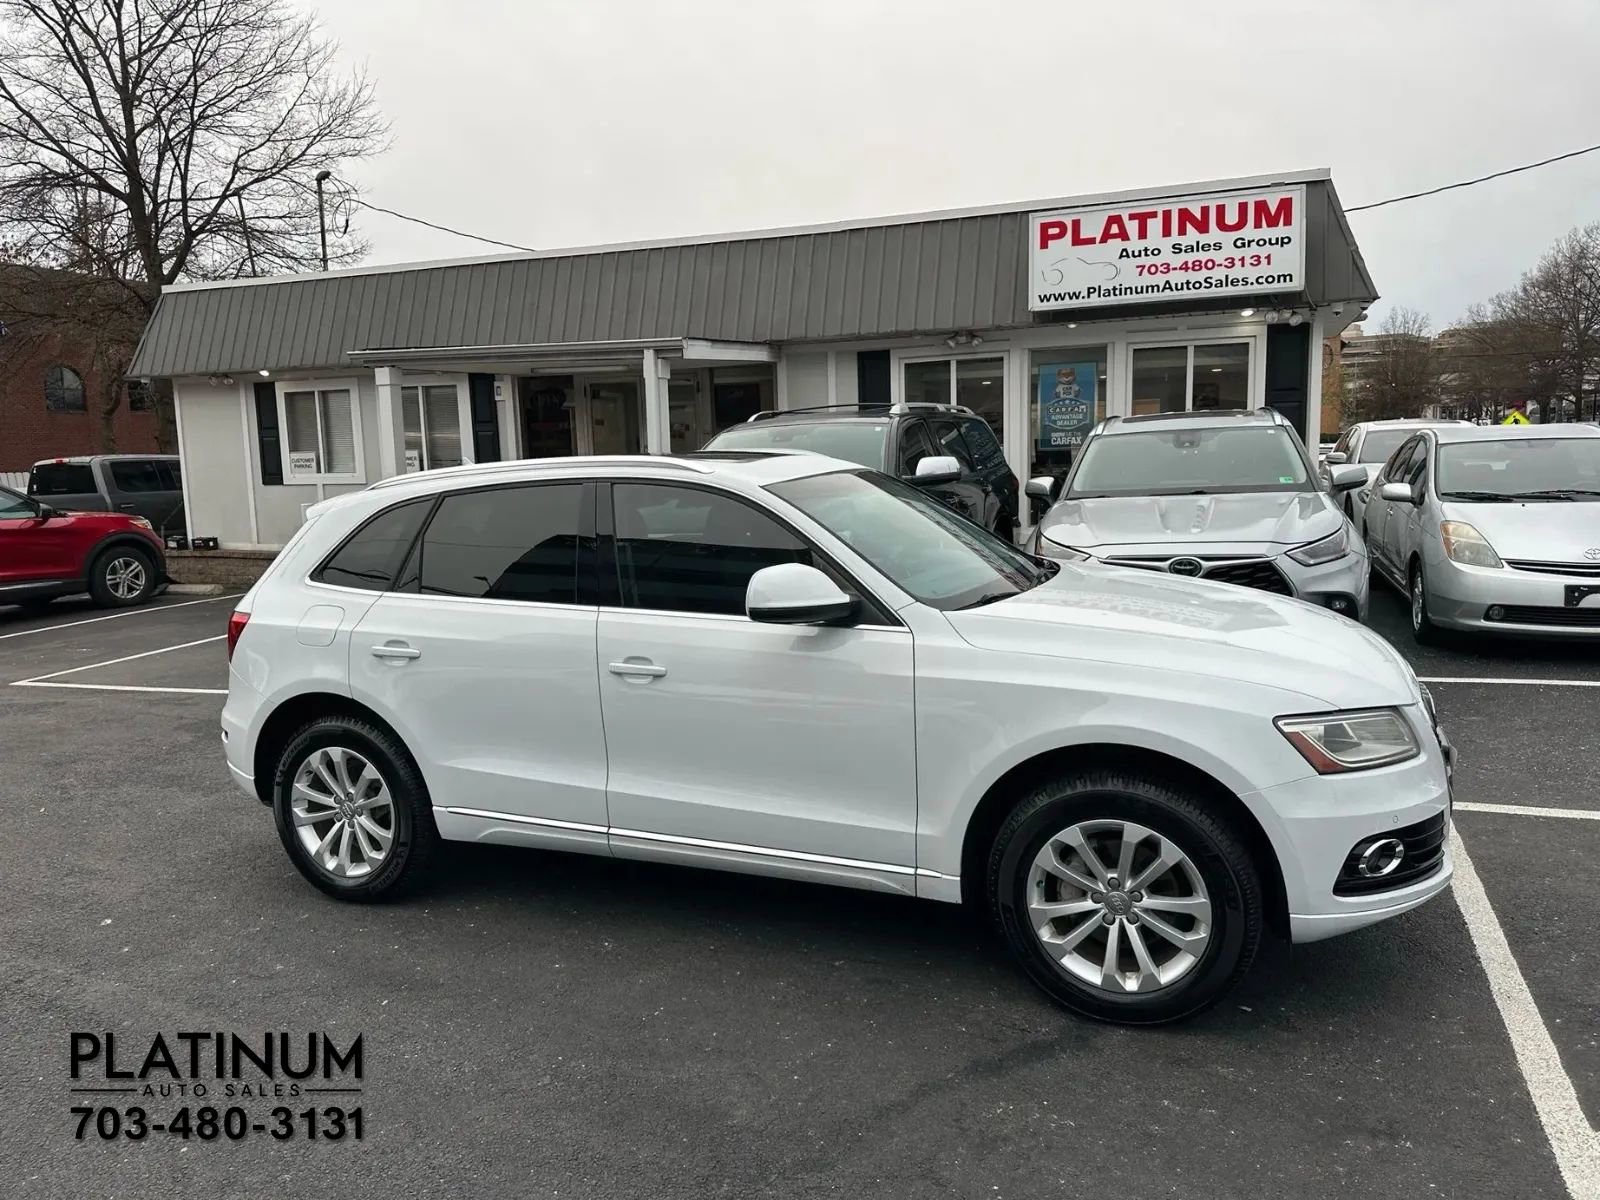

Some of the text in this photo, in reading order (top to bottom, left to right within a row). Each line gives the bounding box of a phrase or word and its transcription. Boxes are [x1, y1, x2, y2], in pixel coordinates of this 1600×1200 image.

[1039, 197, 1293, 250] PLATINUM
[1118, 235, 1292, 260] Auto Sales Group
[1135, 253, 1273, 277] 703-480-3131
[1038, 271, 1294, 303] www.PlatinumAutoSales.com
[1051, 436, 1082, 445] CARFAX
